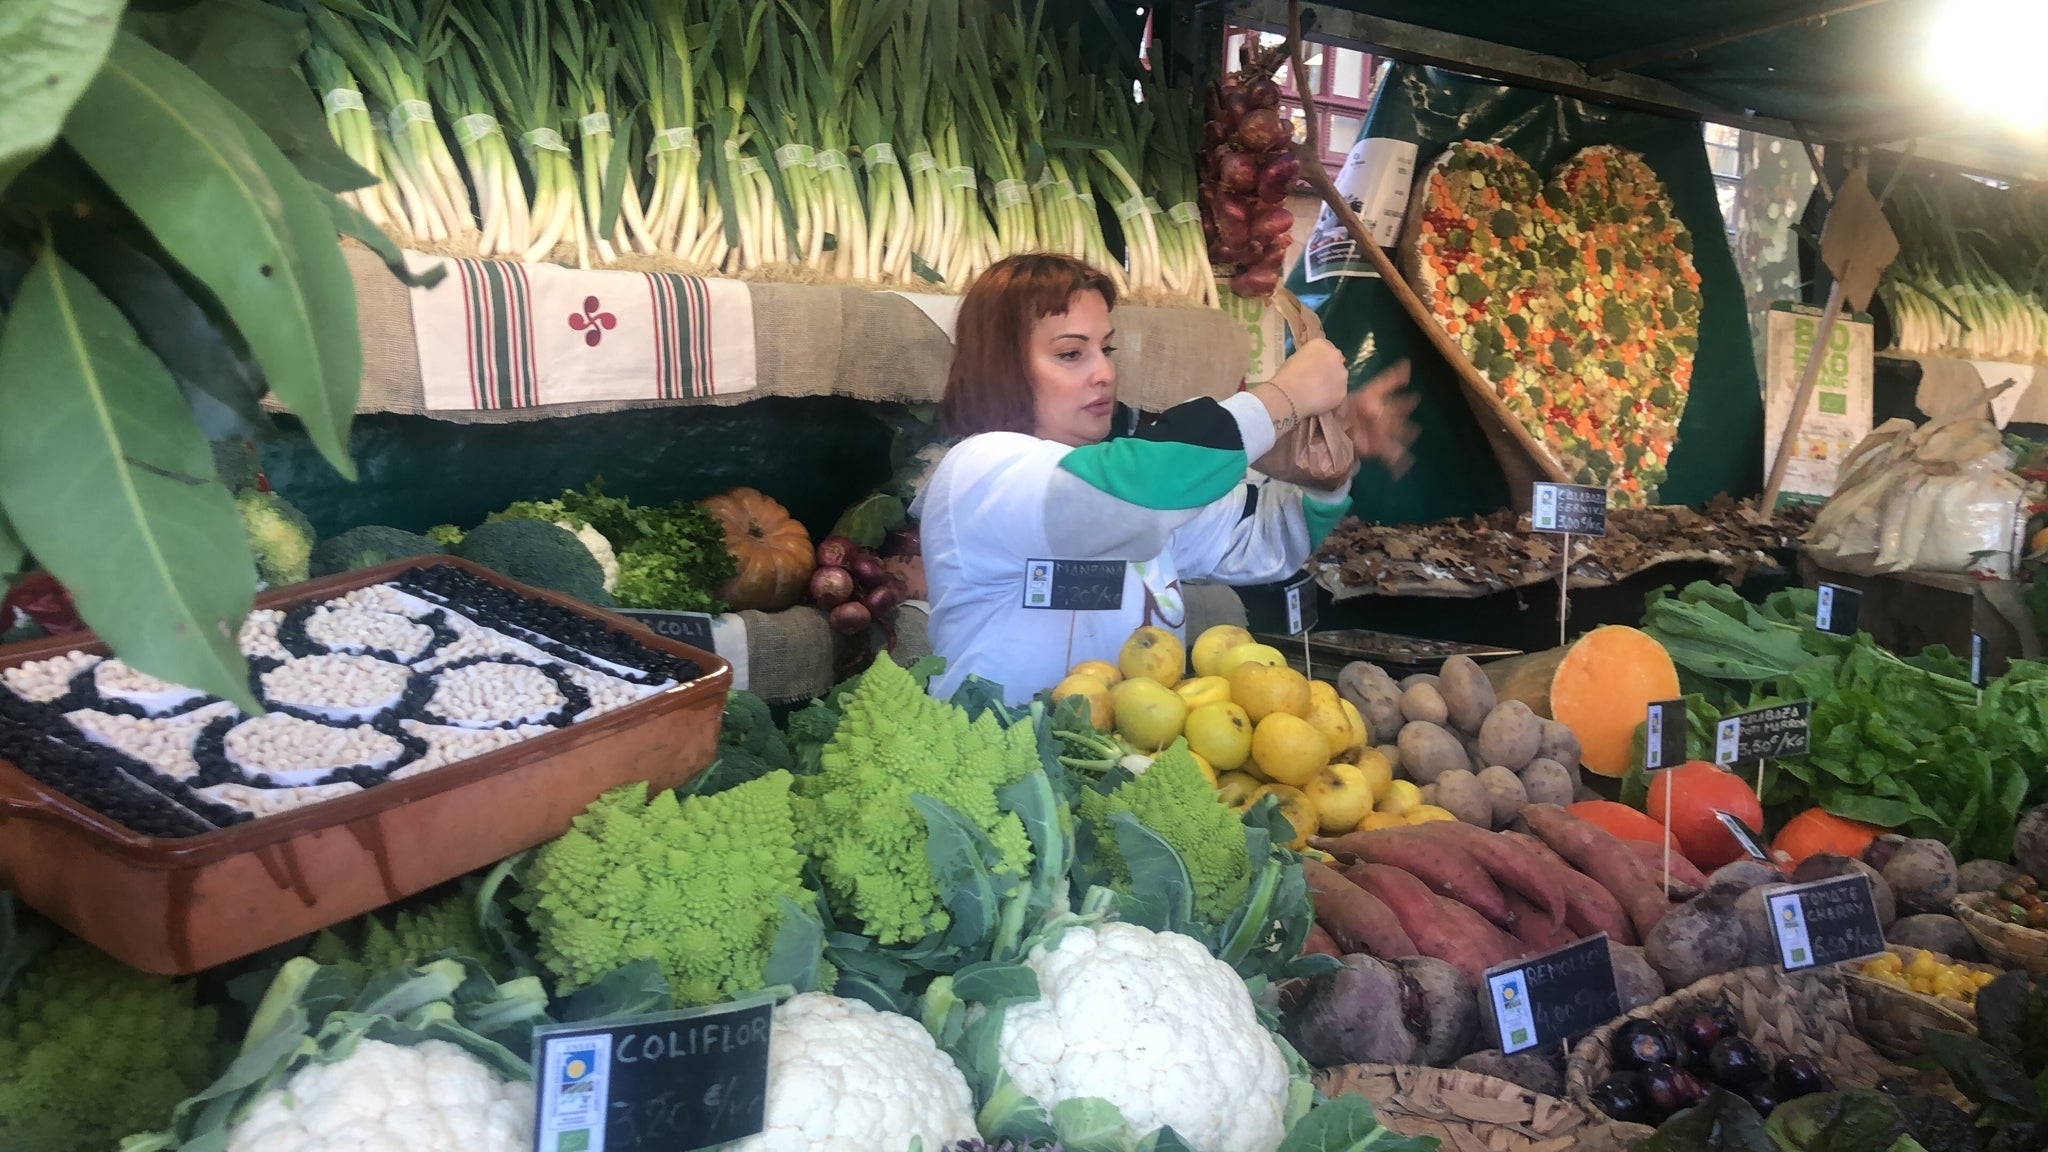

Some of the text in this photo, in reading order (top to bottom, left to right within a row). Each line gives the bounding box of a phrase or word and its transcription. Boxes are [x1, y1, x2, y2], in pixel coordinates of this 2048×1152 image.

[1795, 318, 1850, 352] BO
[1793, 346, 1849, 377] EO
[1740, 706, 1800, 724] CALABAZA
[1801, 886, 1857, 906] TOMATE
[1806, 901, 1865, 922] CHERRY
[616, 1015, 768, 1064] COLIFLOR
